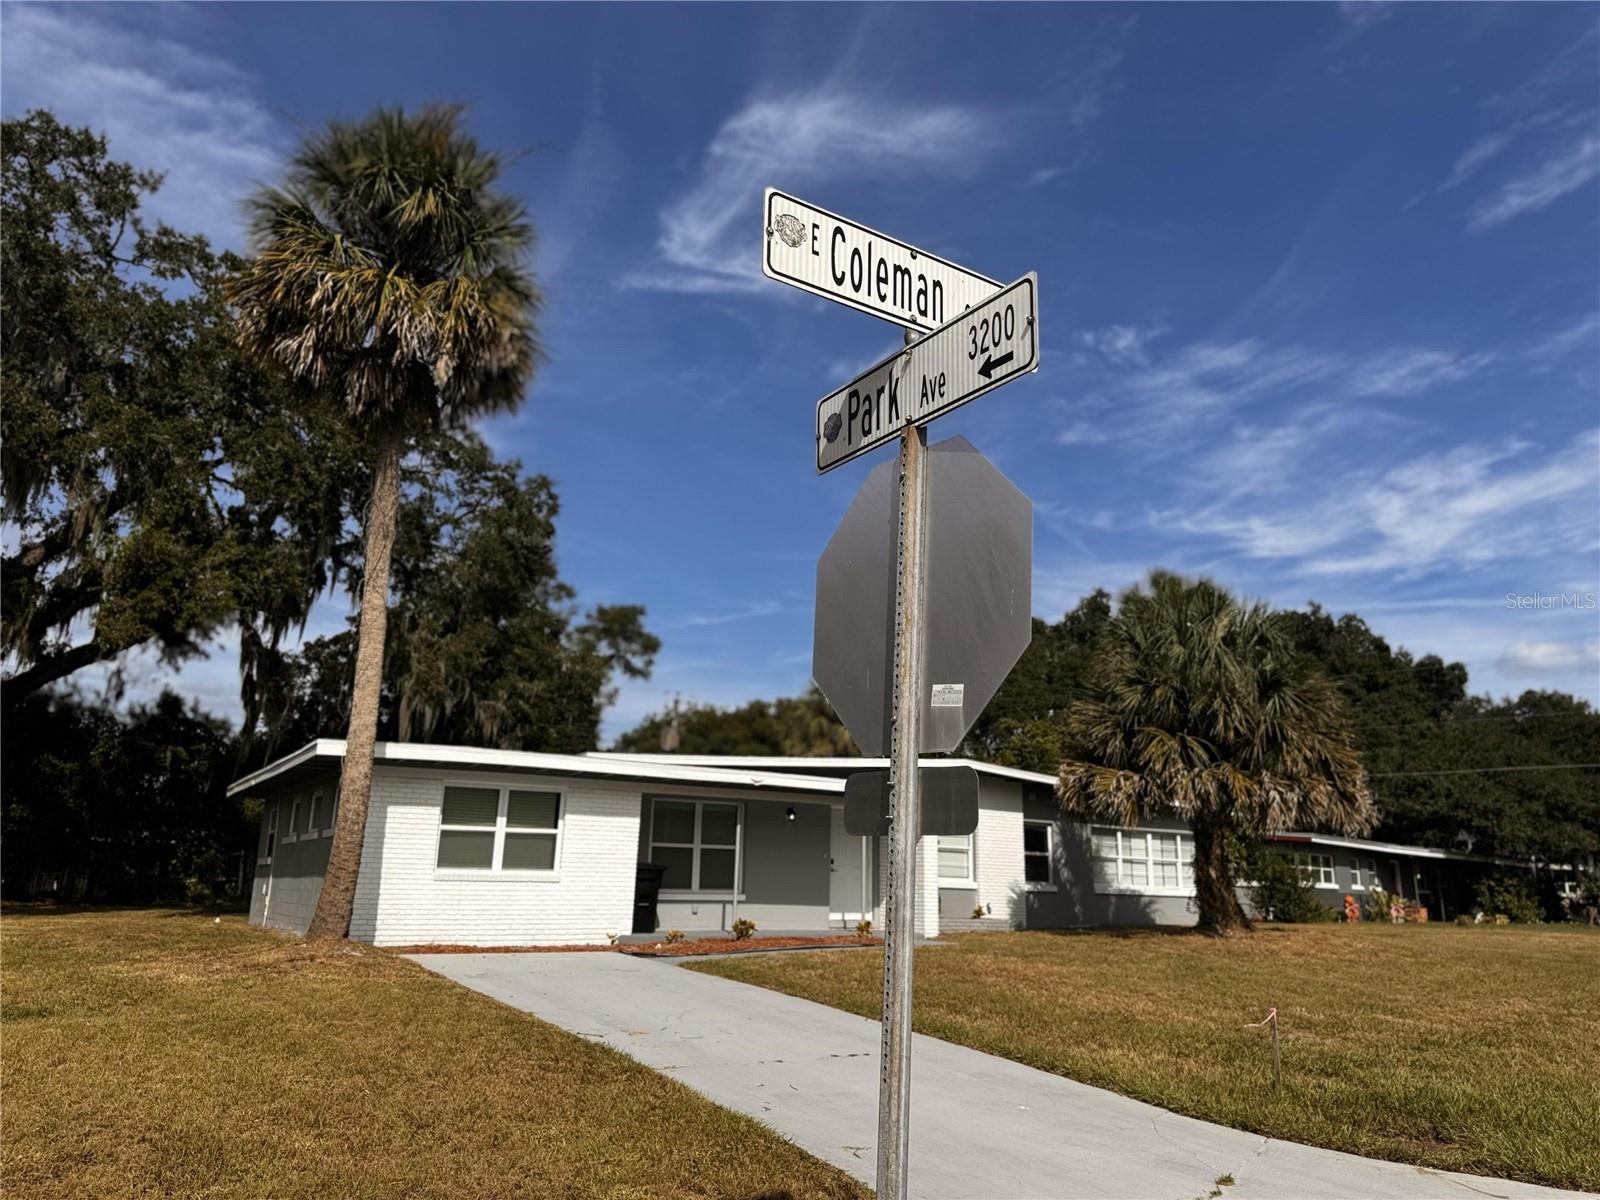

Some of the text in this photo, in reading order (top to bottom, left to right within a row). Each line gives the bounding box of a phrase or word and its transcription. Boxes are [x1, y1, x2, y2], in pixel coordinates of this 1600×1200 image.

[811, 223, 944, 324] E Coleman
[968, 303, 1015, 361] 3200
[847, 368, 946, 446] Park Ave
